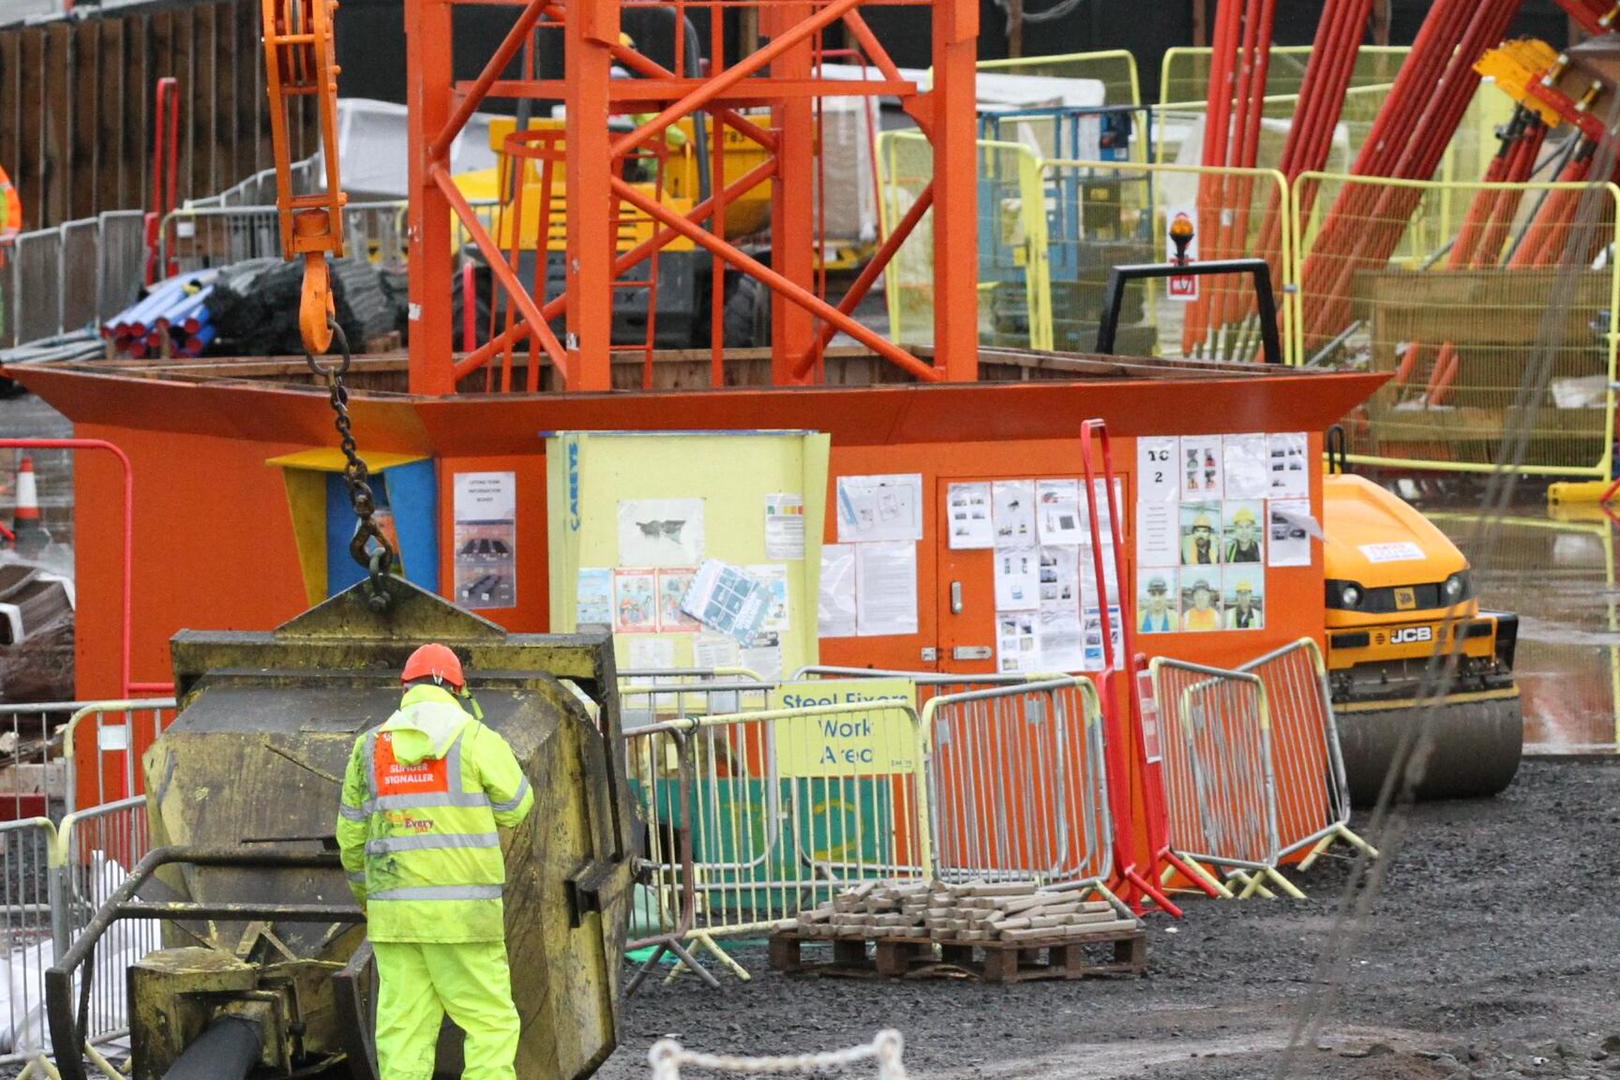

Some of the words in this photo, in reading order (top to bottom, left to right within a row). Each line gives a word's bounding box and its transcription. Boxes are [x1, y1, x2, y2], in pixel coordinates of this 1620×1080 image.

[568, 441, 580, 532] CAREYS
[1155, 472, 1163, 483] 2
[1391, 626, 1432, 644] JCB
[818, 719, 872, 738] Work
[384, 774, 434, 785] SIGNALLER
